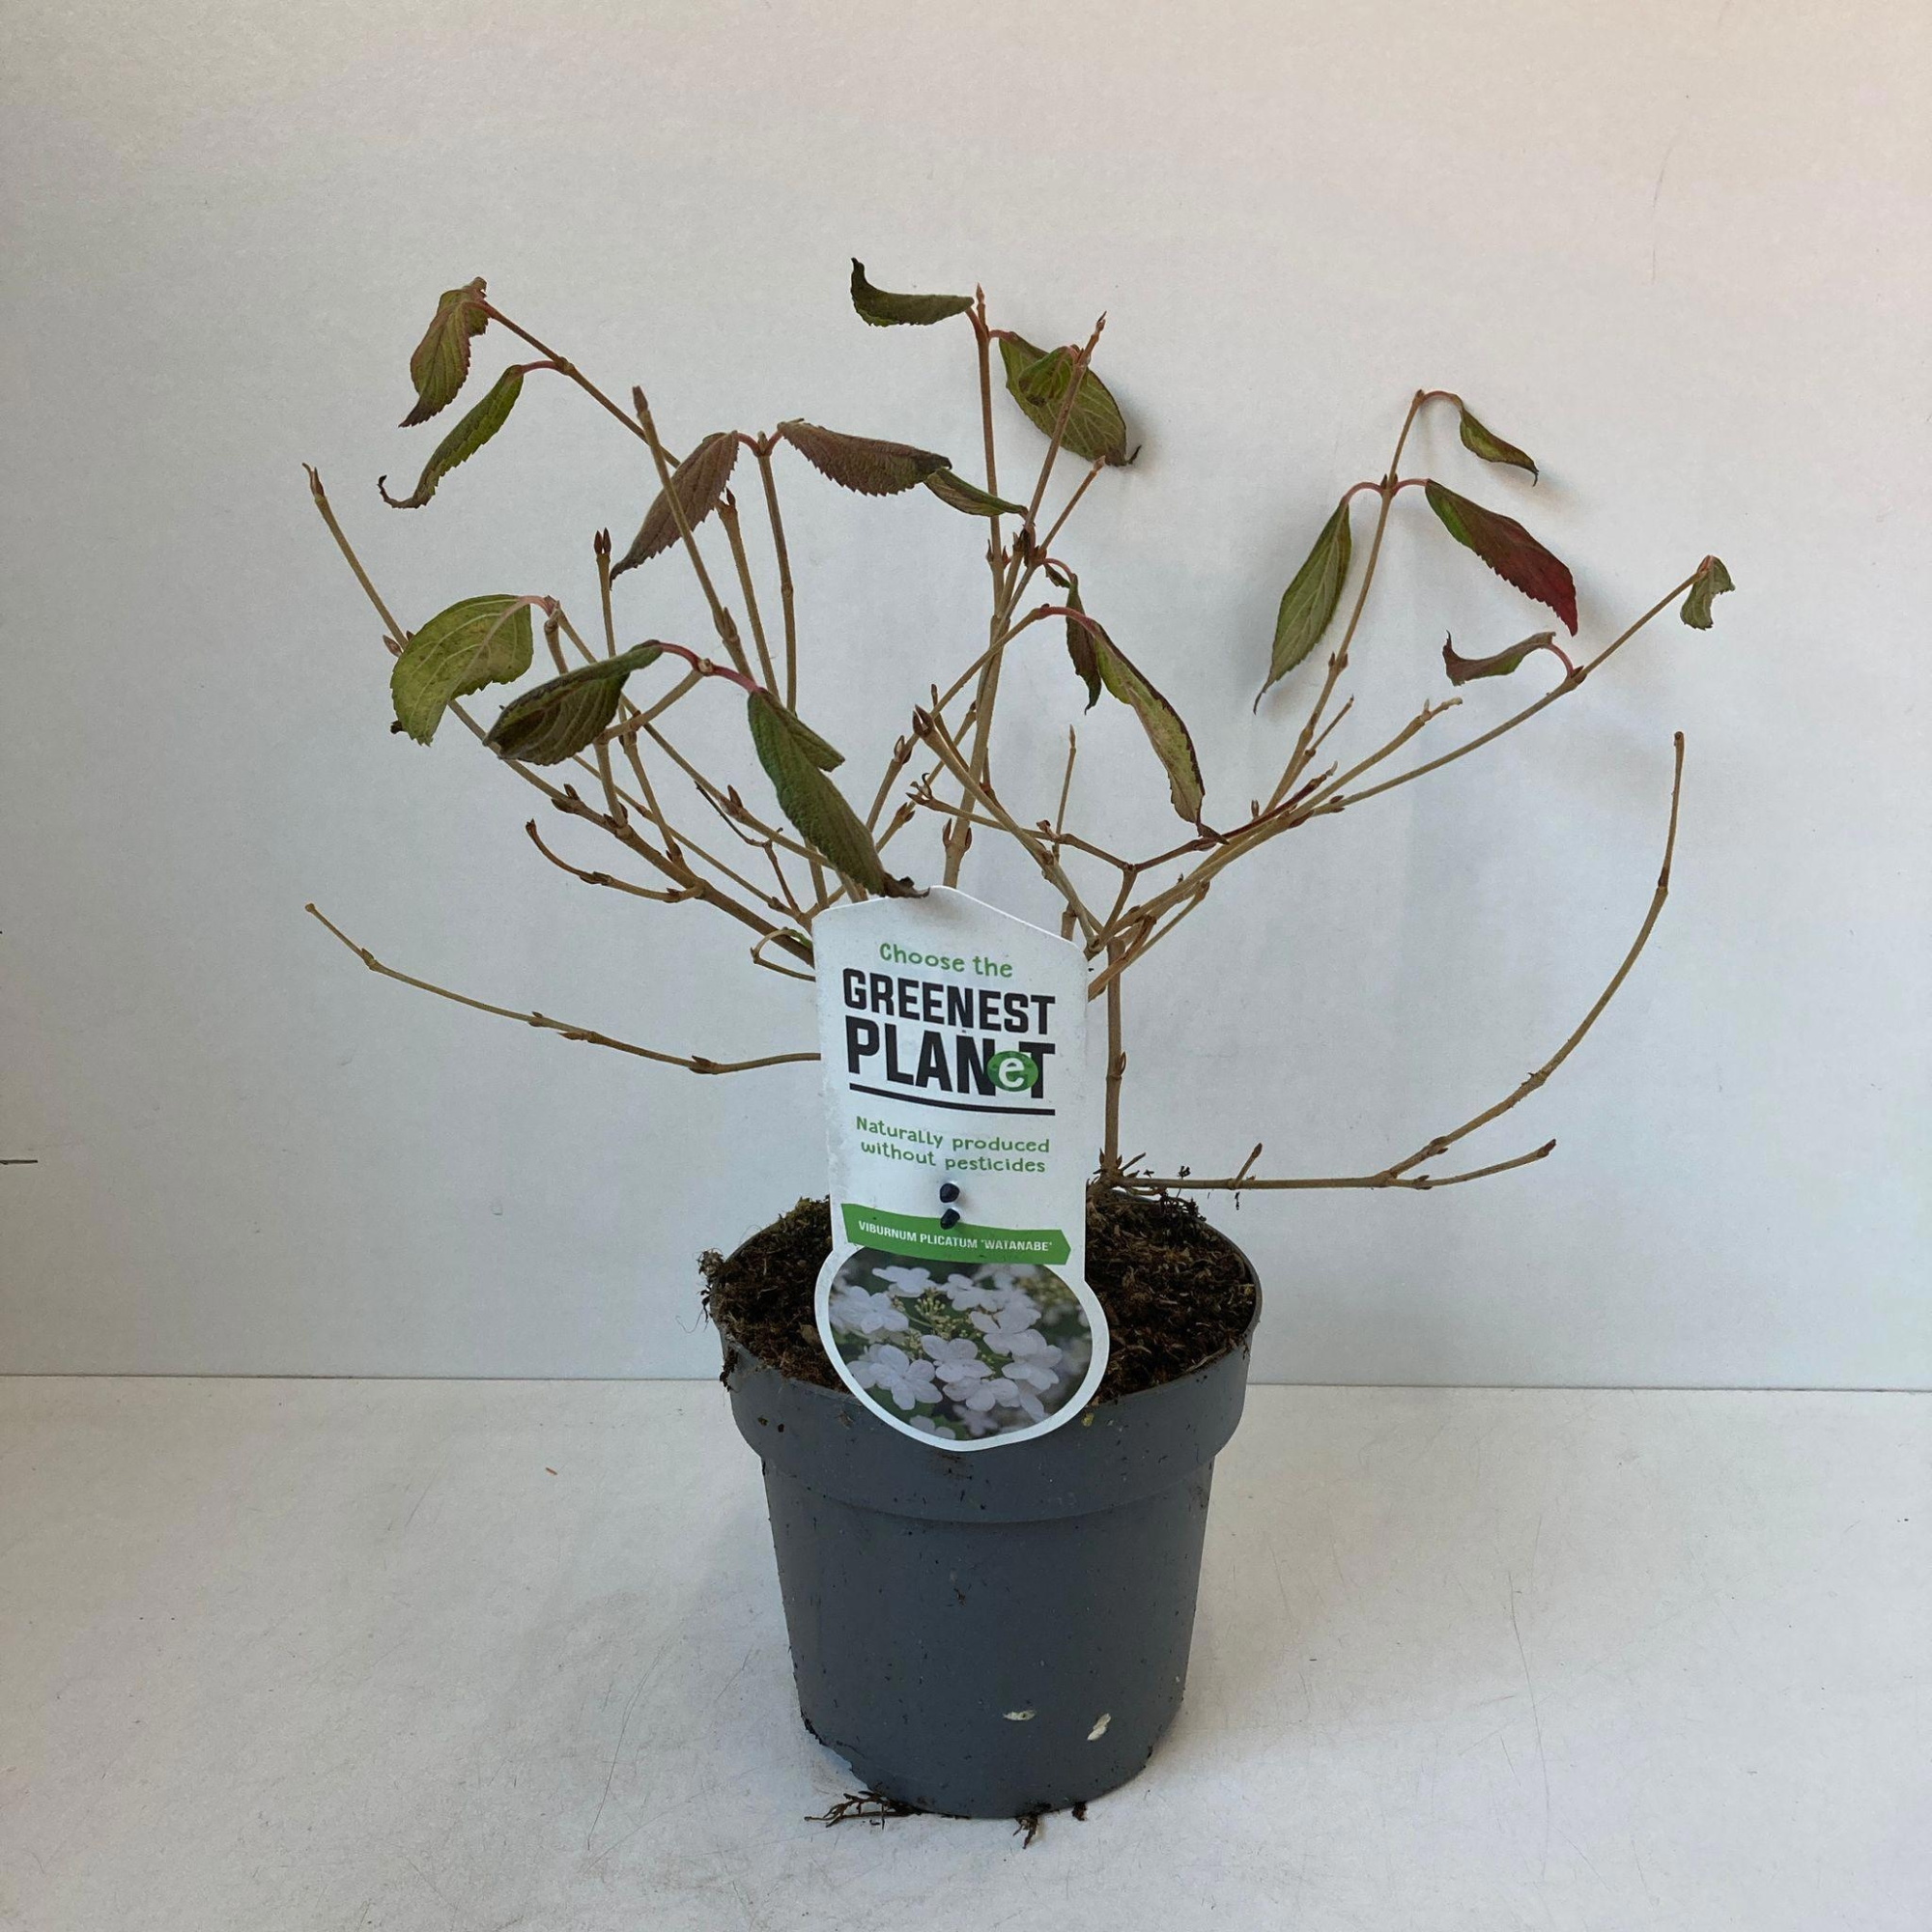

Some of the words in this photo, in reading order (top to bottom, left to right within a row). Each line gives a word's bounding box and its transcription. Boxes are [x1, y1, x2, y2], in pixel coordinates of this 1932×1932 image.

[879, 942, 965, 973] Choose
[972, 955, 1013, 978] the
[842, 968, 1056, 1035] GREENEST
[856, 1116, 944, 1149] Naturally
[952, 1137, 1051, 1152] produced
[861, 1140, 937, 1166] without
[945, 1156, 1046, 1173] pesticides
[858, 1220, 917, 1242] VIBURNUM
[920, 1233, 978, 1249] PLICATUM
